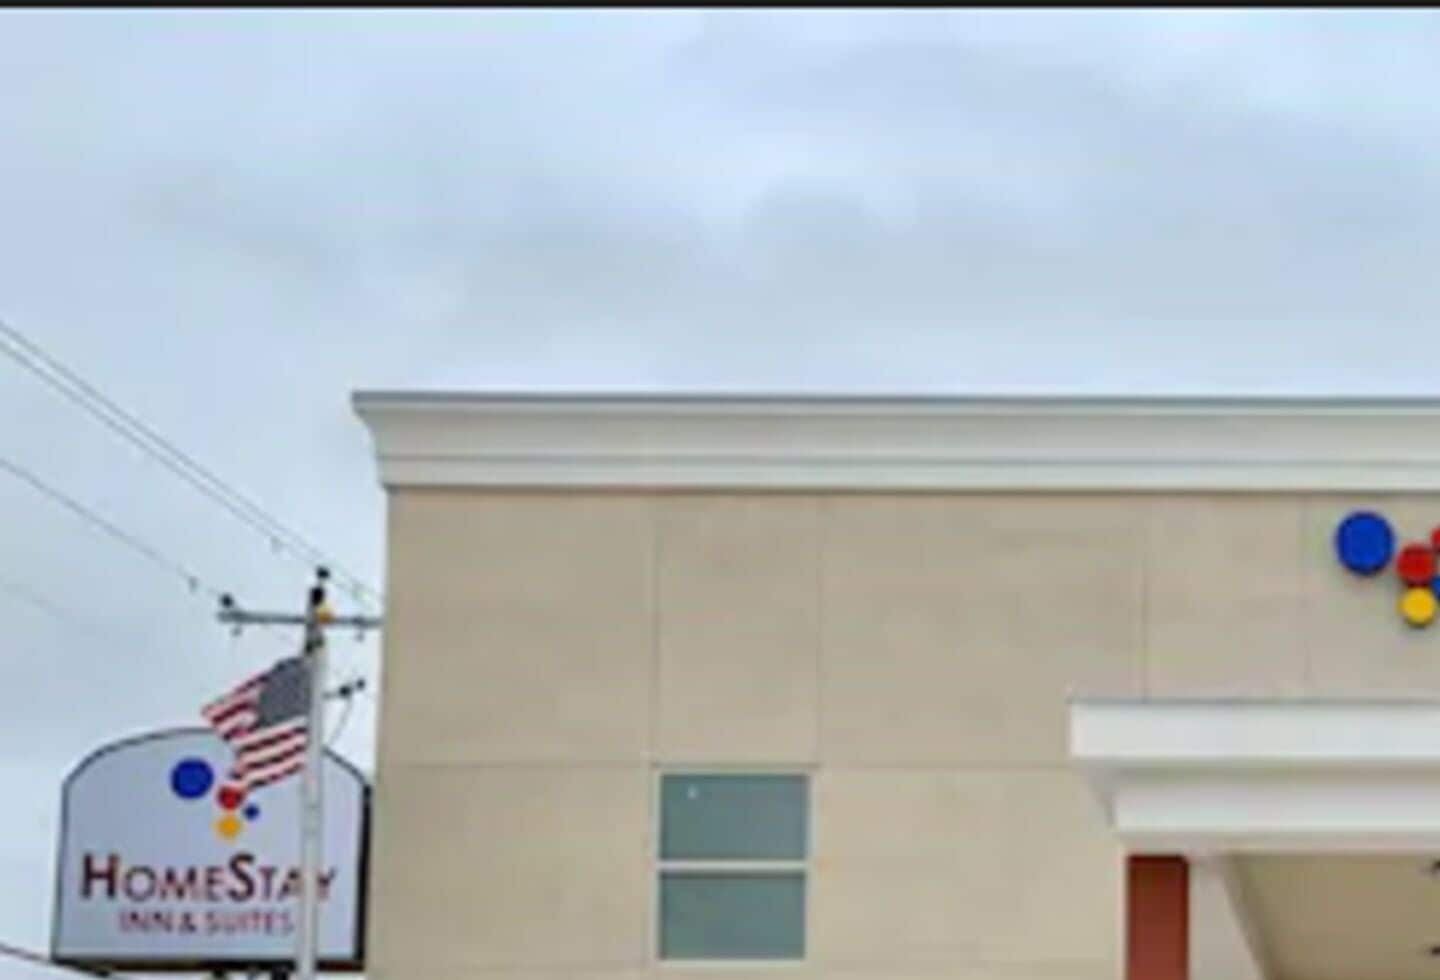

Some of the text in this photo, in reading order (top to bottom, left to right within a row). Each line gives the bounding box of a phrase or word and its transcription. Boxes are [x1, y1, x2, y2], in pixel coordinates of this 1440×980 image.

[119, 909, 295, 934] INN & SUITES
